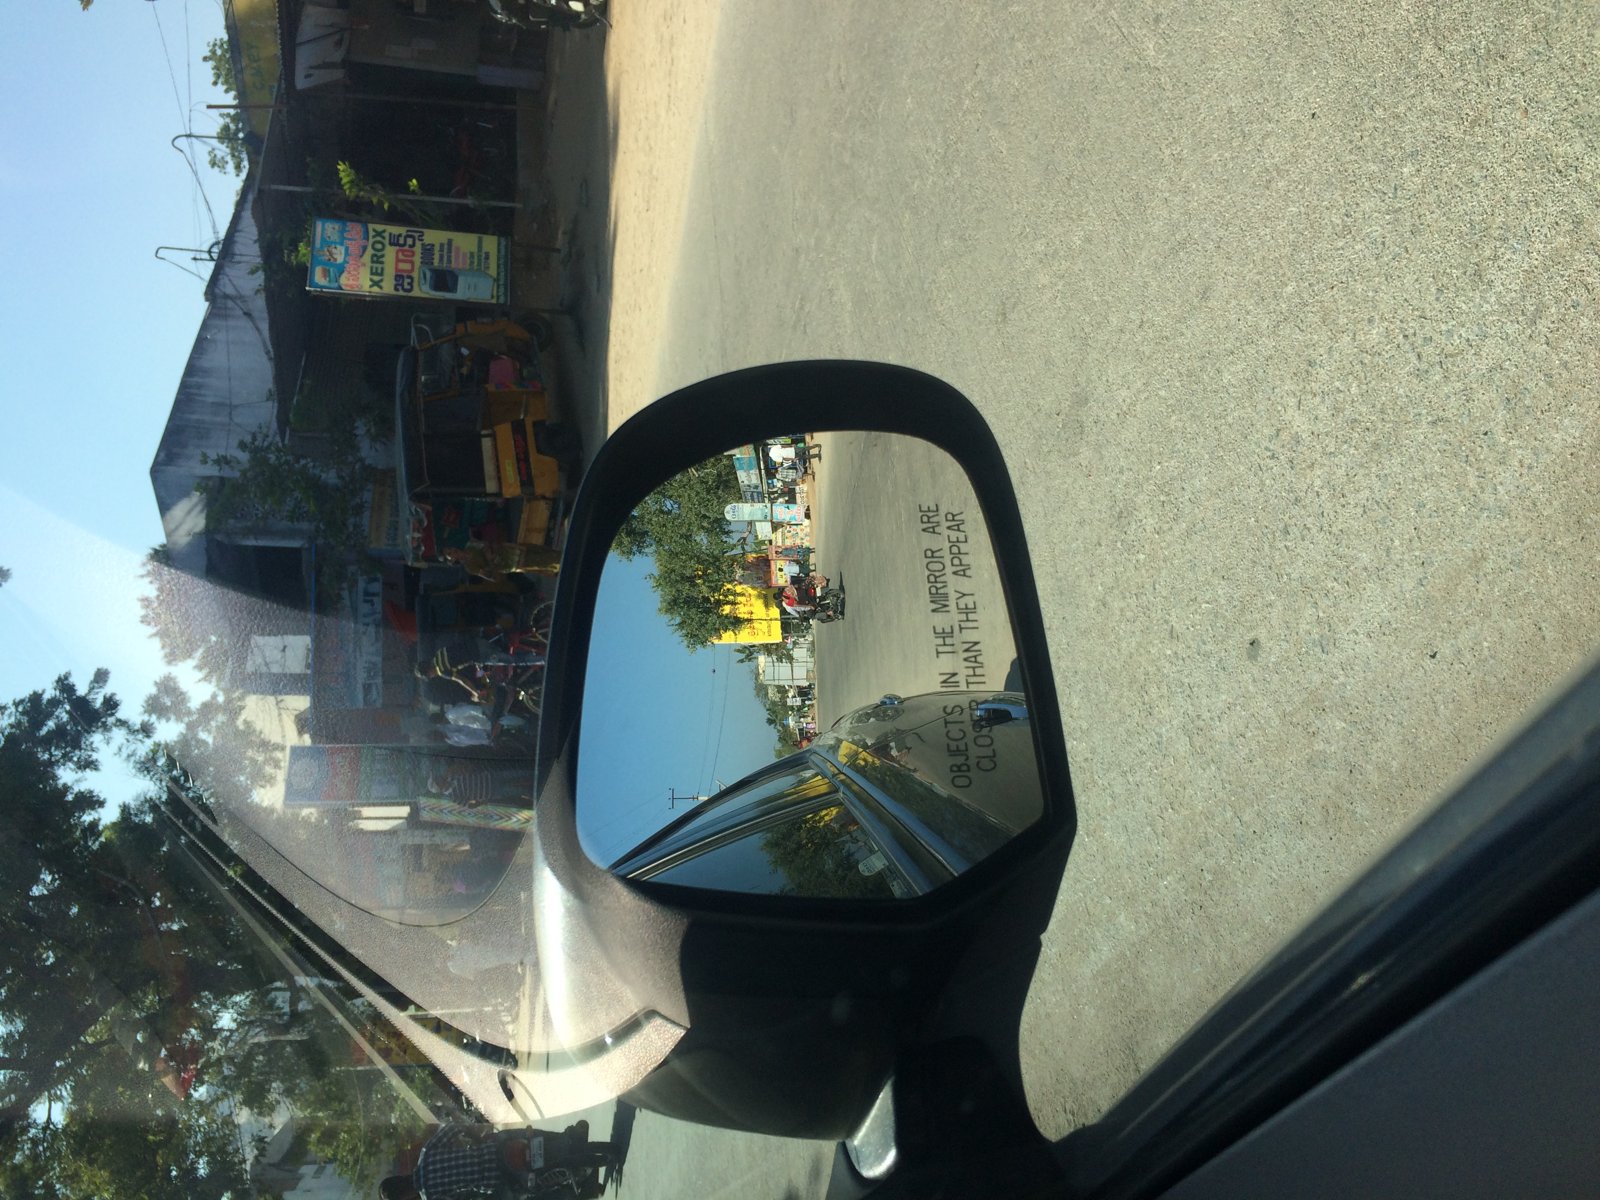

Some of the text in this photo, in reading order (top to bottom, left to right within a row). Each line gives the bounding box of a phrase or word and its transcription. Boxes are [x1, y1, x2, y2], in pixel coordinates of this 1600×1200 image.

[369, 228, 386, 290] XEROX
[945, 511, 972, 578] APPEAR
[954, 590, 979, 633] THEY
[919, 504, 972, 789] OBJECTS IN THE MIRROR ARE
[961, 641, 986, 688] THAN
